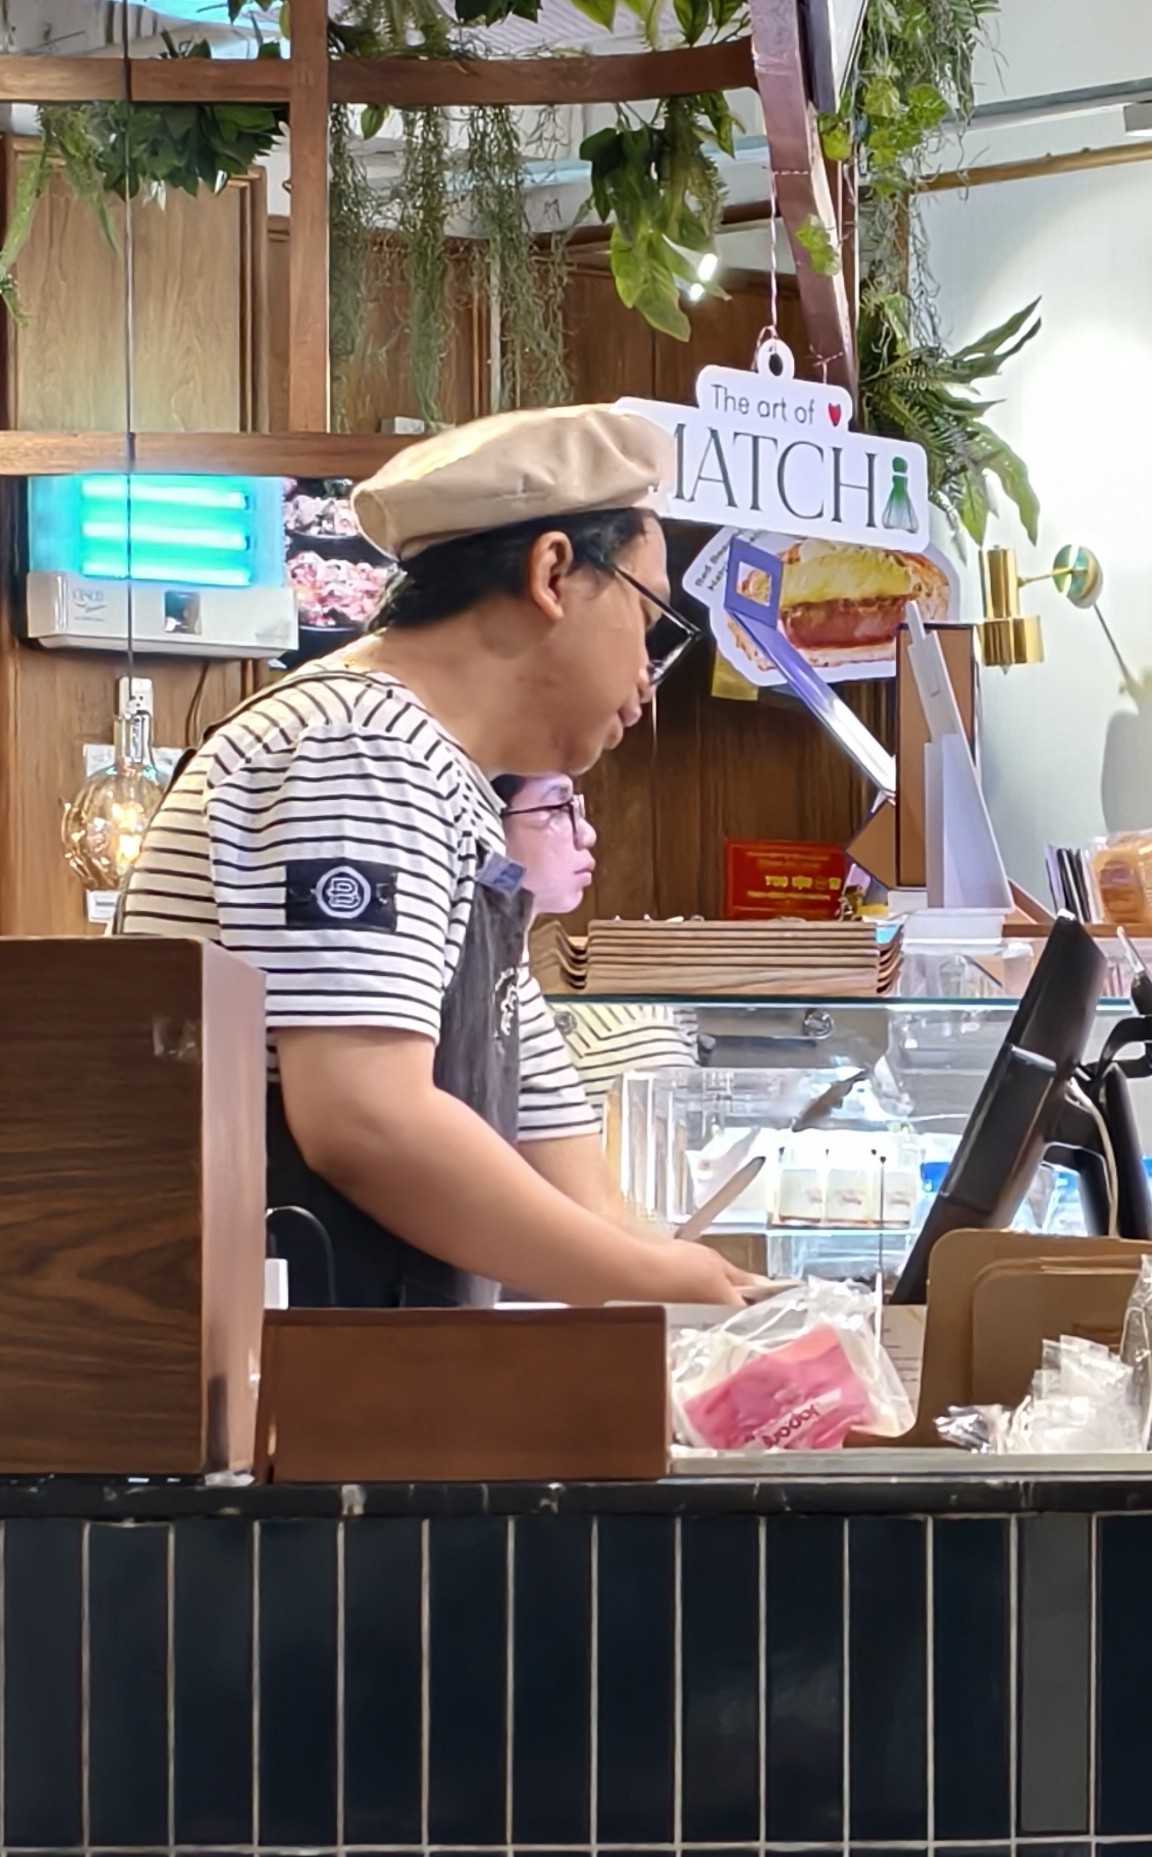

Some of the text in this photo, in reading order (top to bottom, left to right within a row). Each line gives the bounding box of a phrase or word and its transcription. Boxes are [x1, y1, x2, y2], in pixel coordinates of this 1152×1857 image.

[711, 383, 815, 424] The art of
